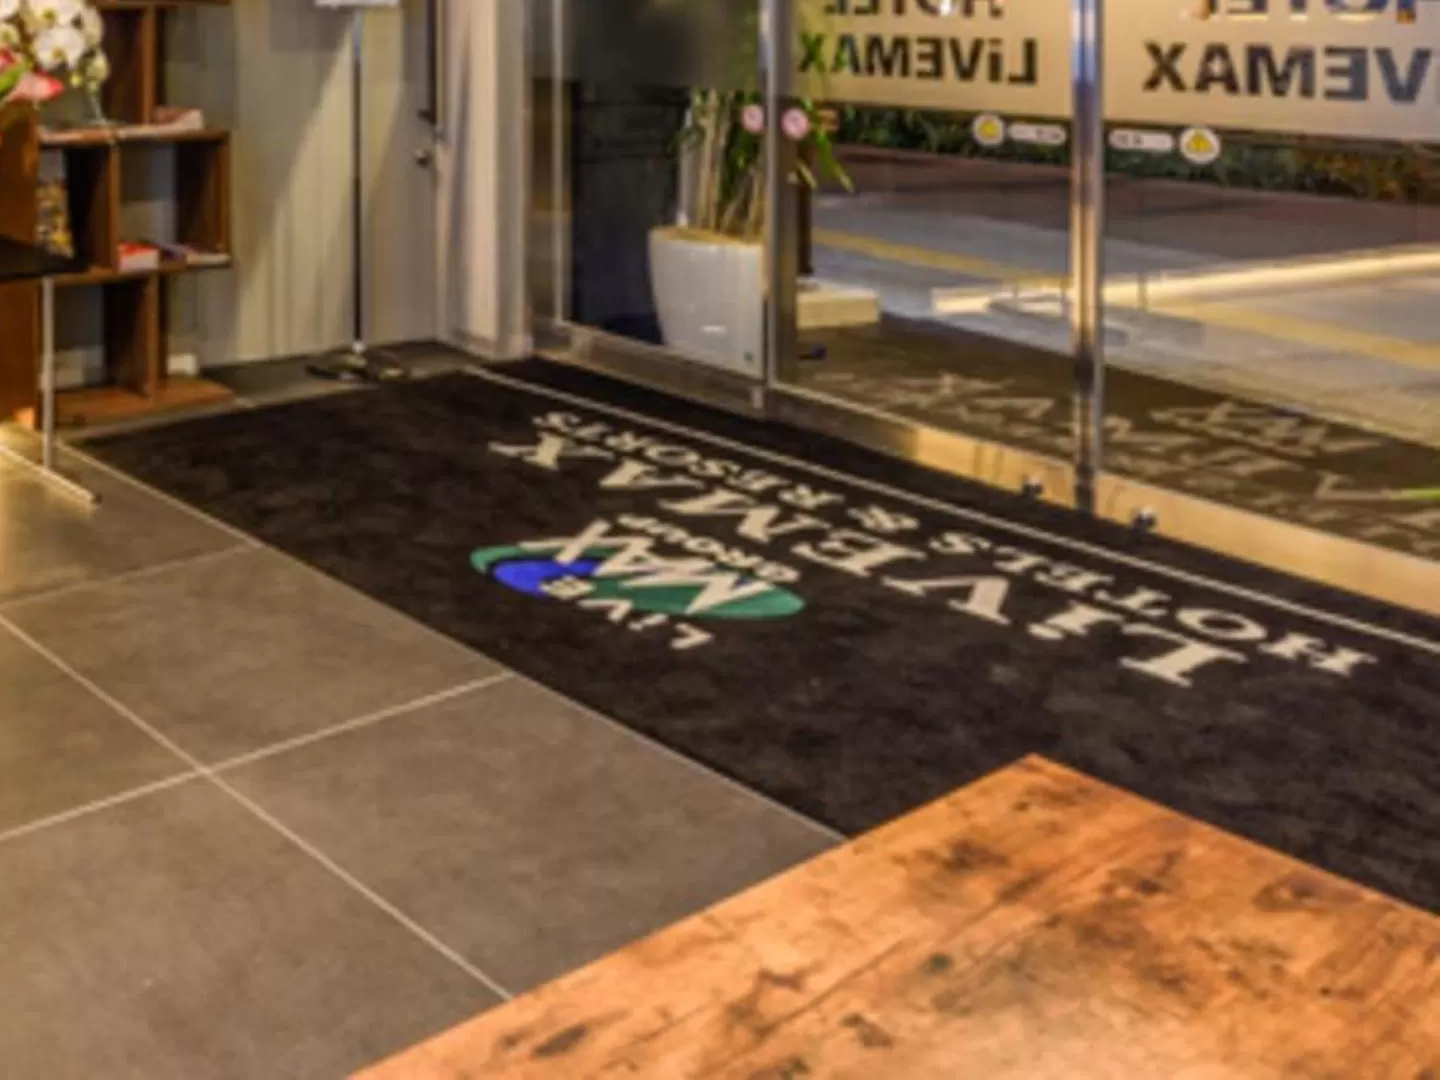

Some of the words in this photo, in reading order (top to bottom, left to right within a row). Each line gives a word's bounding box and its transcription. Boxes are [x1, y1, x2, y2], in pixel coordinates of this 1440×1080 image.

[518, 518, 776, 616] MAX
[616, 514, 802, 583] GROUP
[930, 531, 1378, 677] HOTELS
